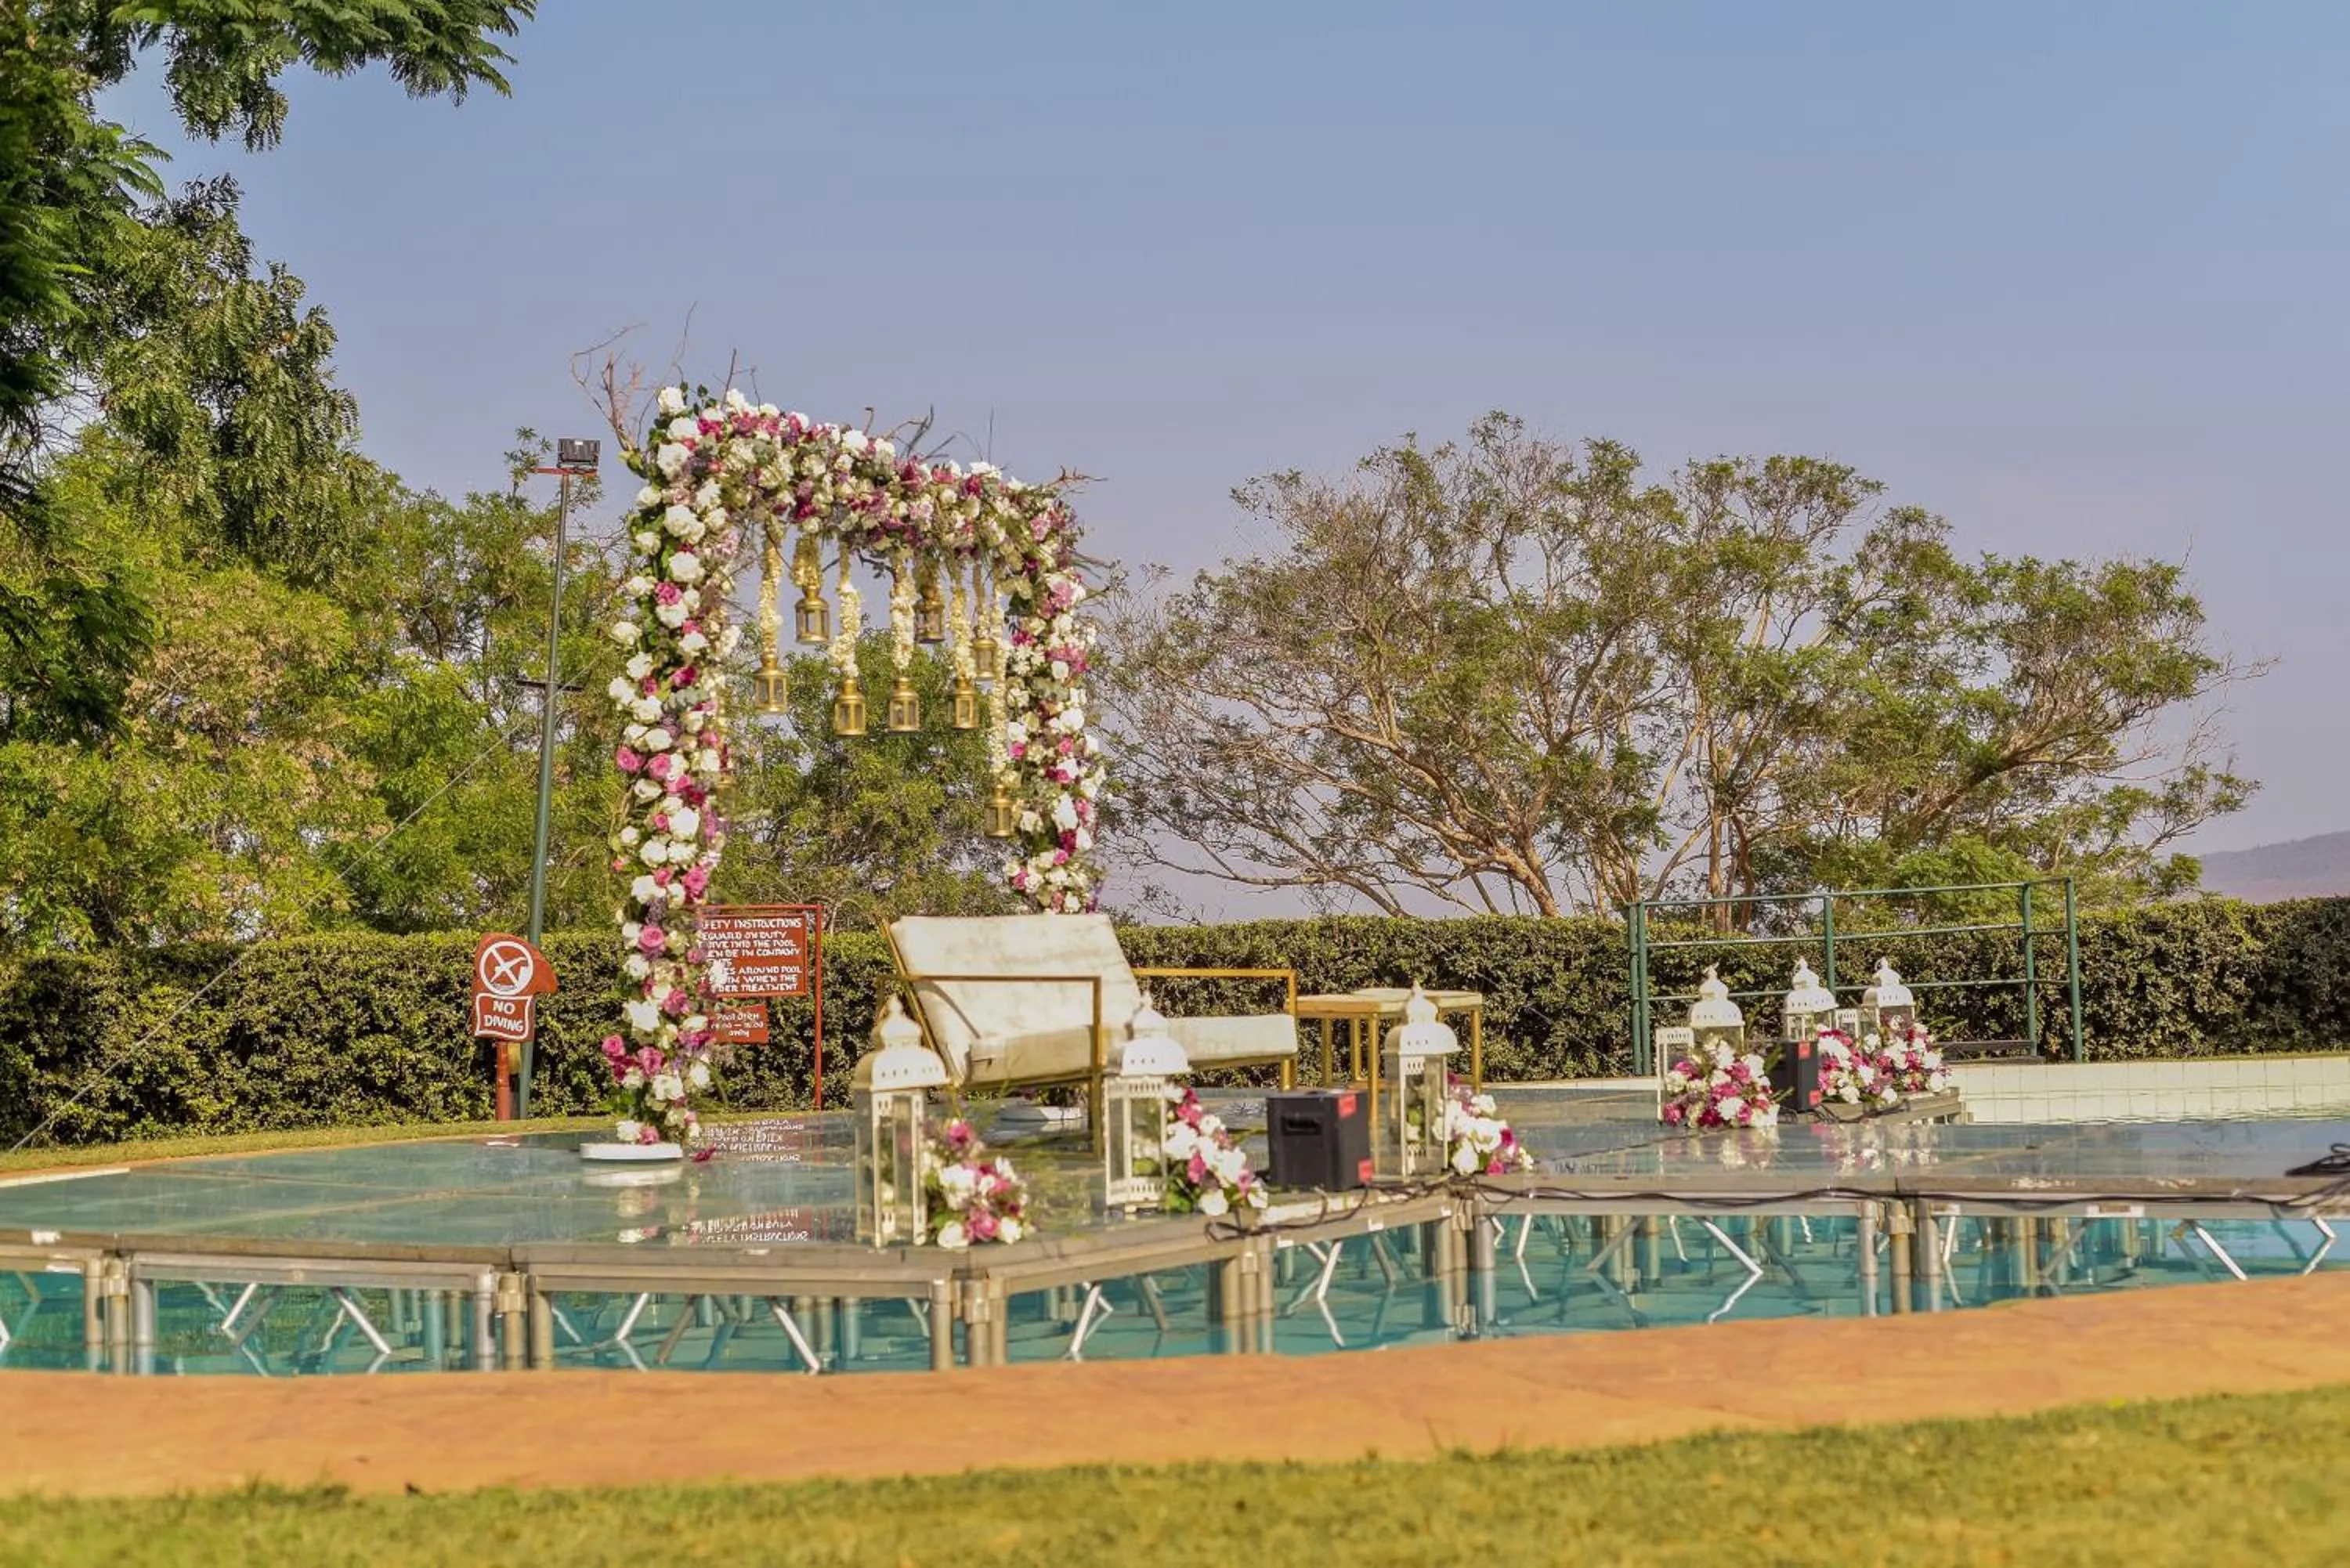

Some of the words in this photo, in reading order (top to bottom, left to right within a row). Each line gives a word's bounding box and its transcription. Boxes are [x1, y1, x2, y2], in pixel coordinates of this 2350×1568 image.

[703, 919, 731, 930] FETY
[734, 918, 802, 928] INSTRUCTIONS
[739, 966, 779, 975] AROUND
[779, 974, 798, 983] THE
[741, 983, 798, 992] TREATMENT
[493, 1001, 516, 1014] NO
[483, 1015, 524, 1031] DIVING
